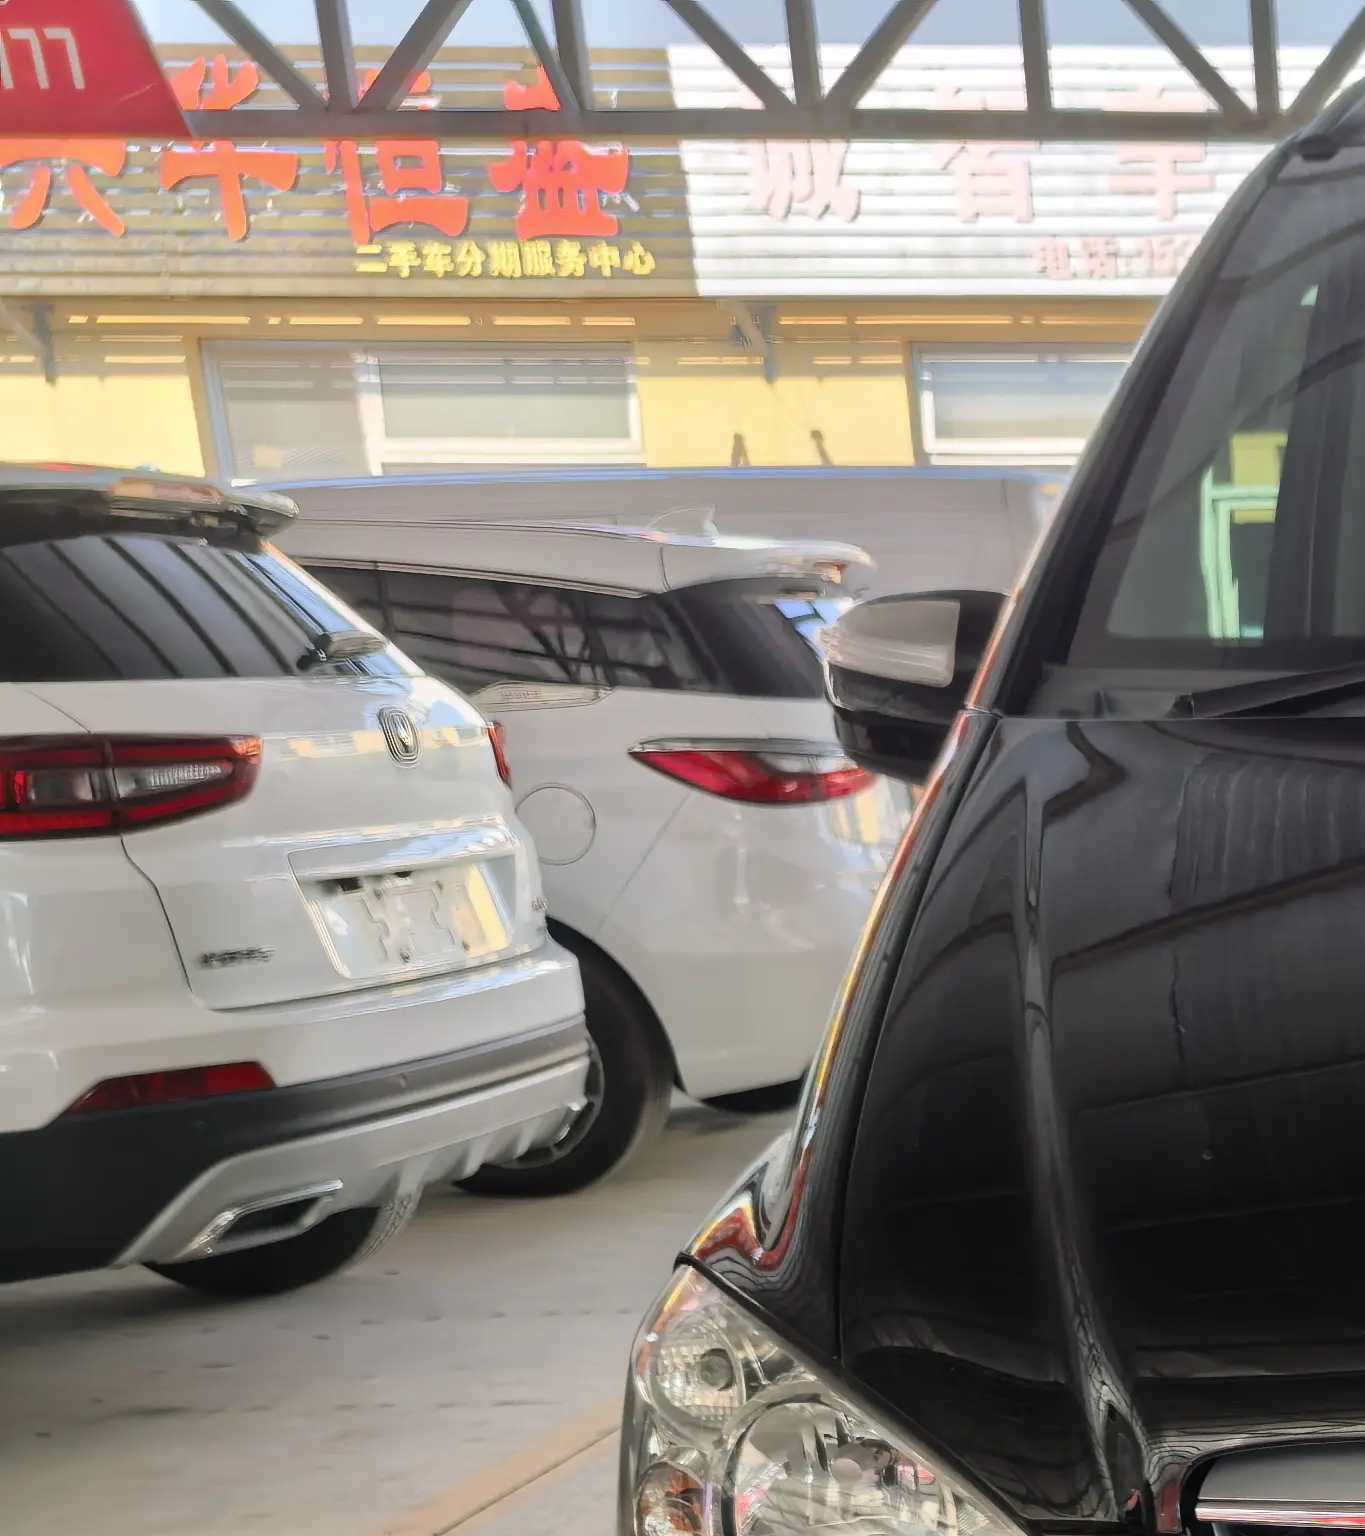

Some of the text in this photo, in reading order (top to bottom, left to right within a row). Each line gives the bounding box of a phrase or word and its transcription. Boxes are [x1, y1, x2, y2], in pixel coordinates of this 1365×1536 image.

[355, 239, 657, 279] 二手车分期服务中心
